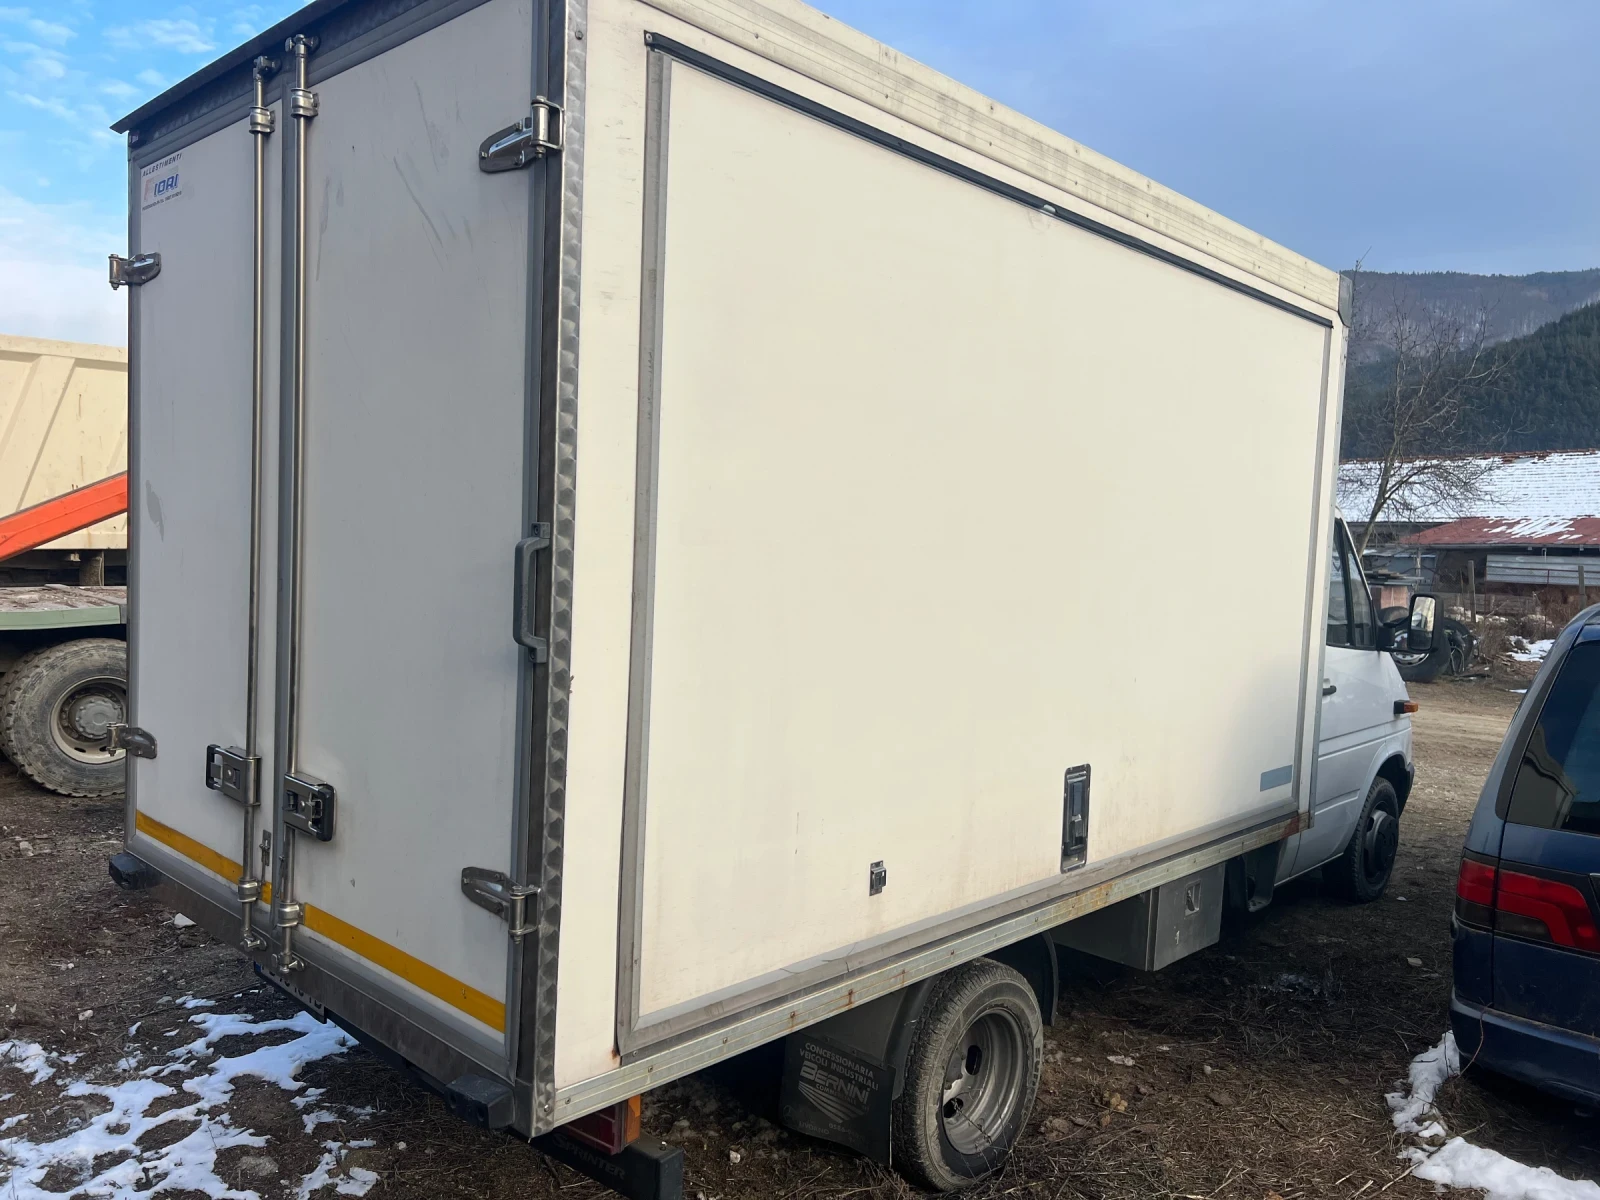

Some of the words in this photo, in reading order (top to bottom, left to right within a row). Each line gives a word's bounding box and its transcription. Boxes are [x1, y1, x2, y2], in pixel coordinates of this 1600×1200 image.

[142, 153, 182, 177] ALLESTIMENTI
[799, 1048, 828, 1067] VEICOLI
[831, 1062, 879, 1091] INDUSTRIALI
[805, 1042, 874, 1079] CONCESSIONARIA
[552, 1131, 625, 1180] SPRINTER
